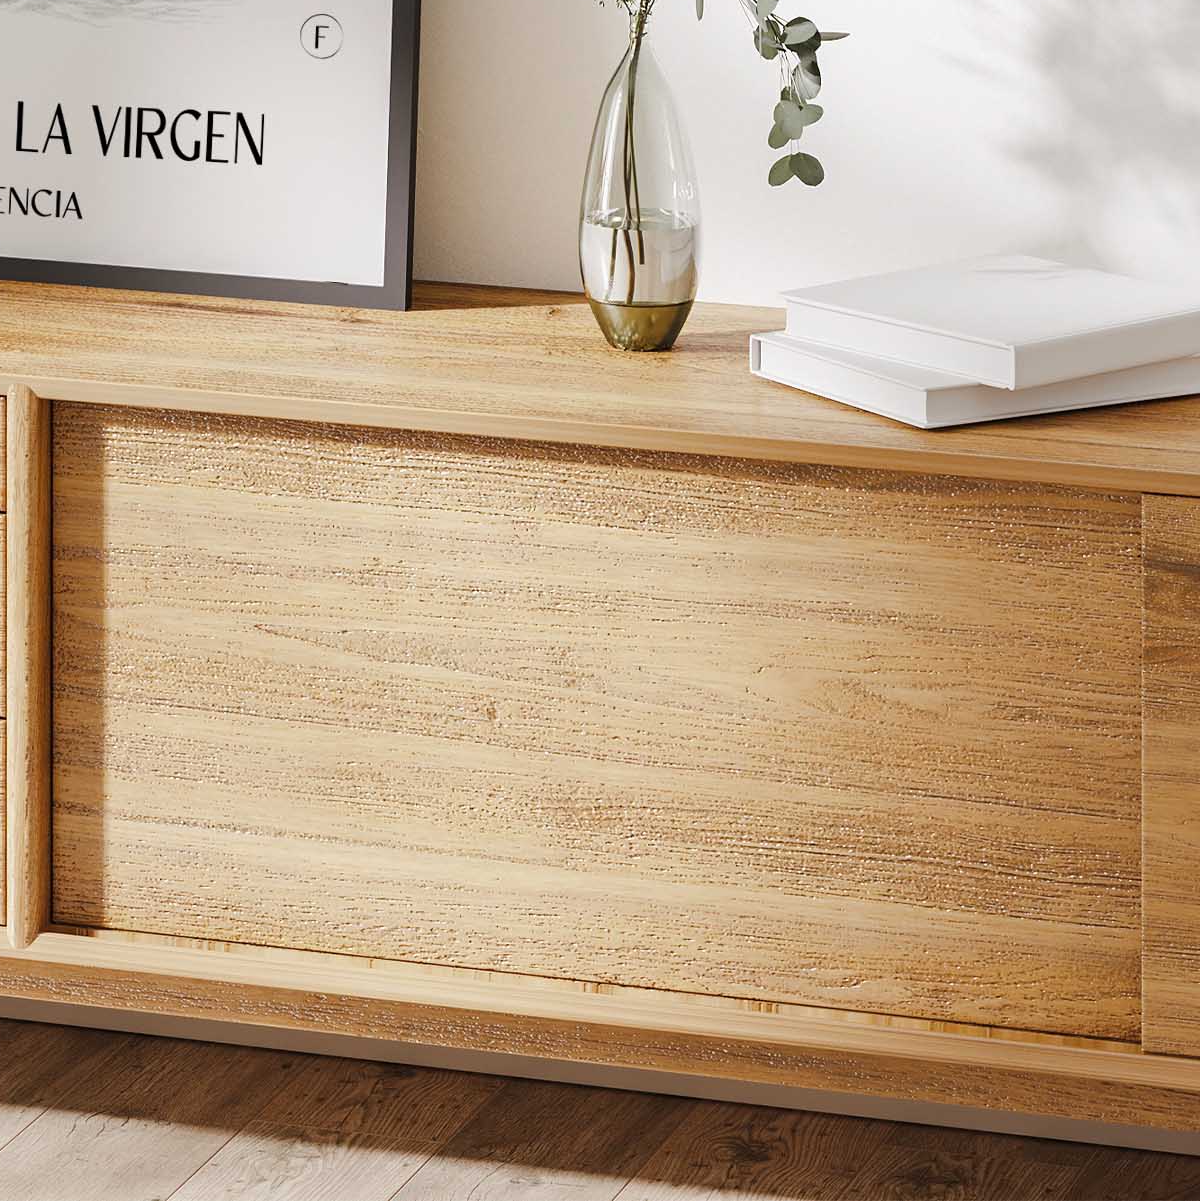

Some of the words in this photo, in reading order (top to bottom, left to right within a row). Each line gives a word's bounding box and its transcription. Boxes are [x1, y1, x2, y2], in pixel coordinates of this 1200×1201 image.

[314, 25, 330, 49] F
[15, 100, 73, 155] LA
[91, 104, 266, 166] VIRGEN
